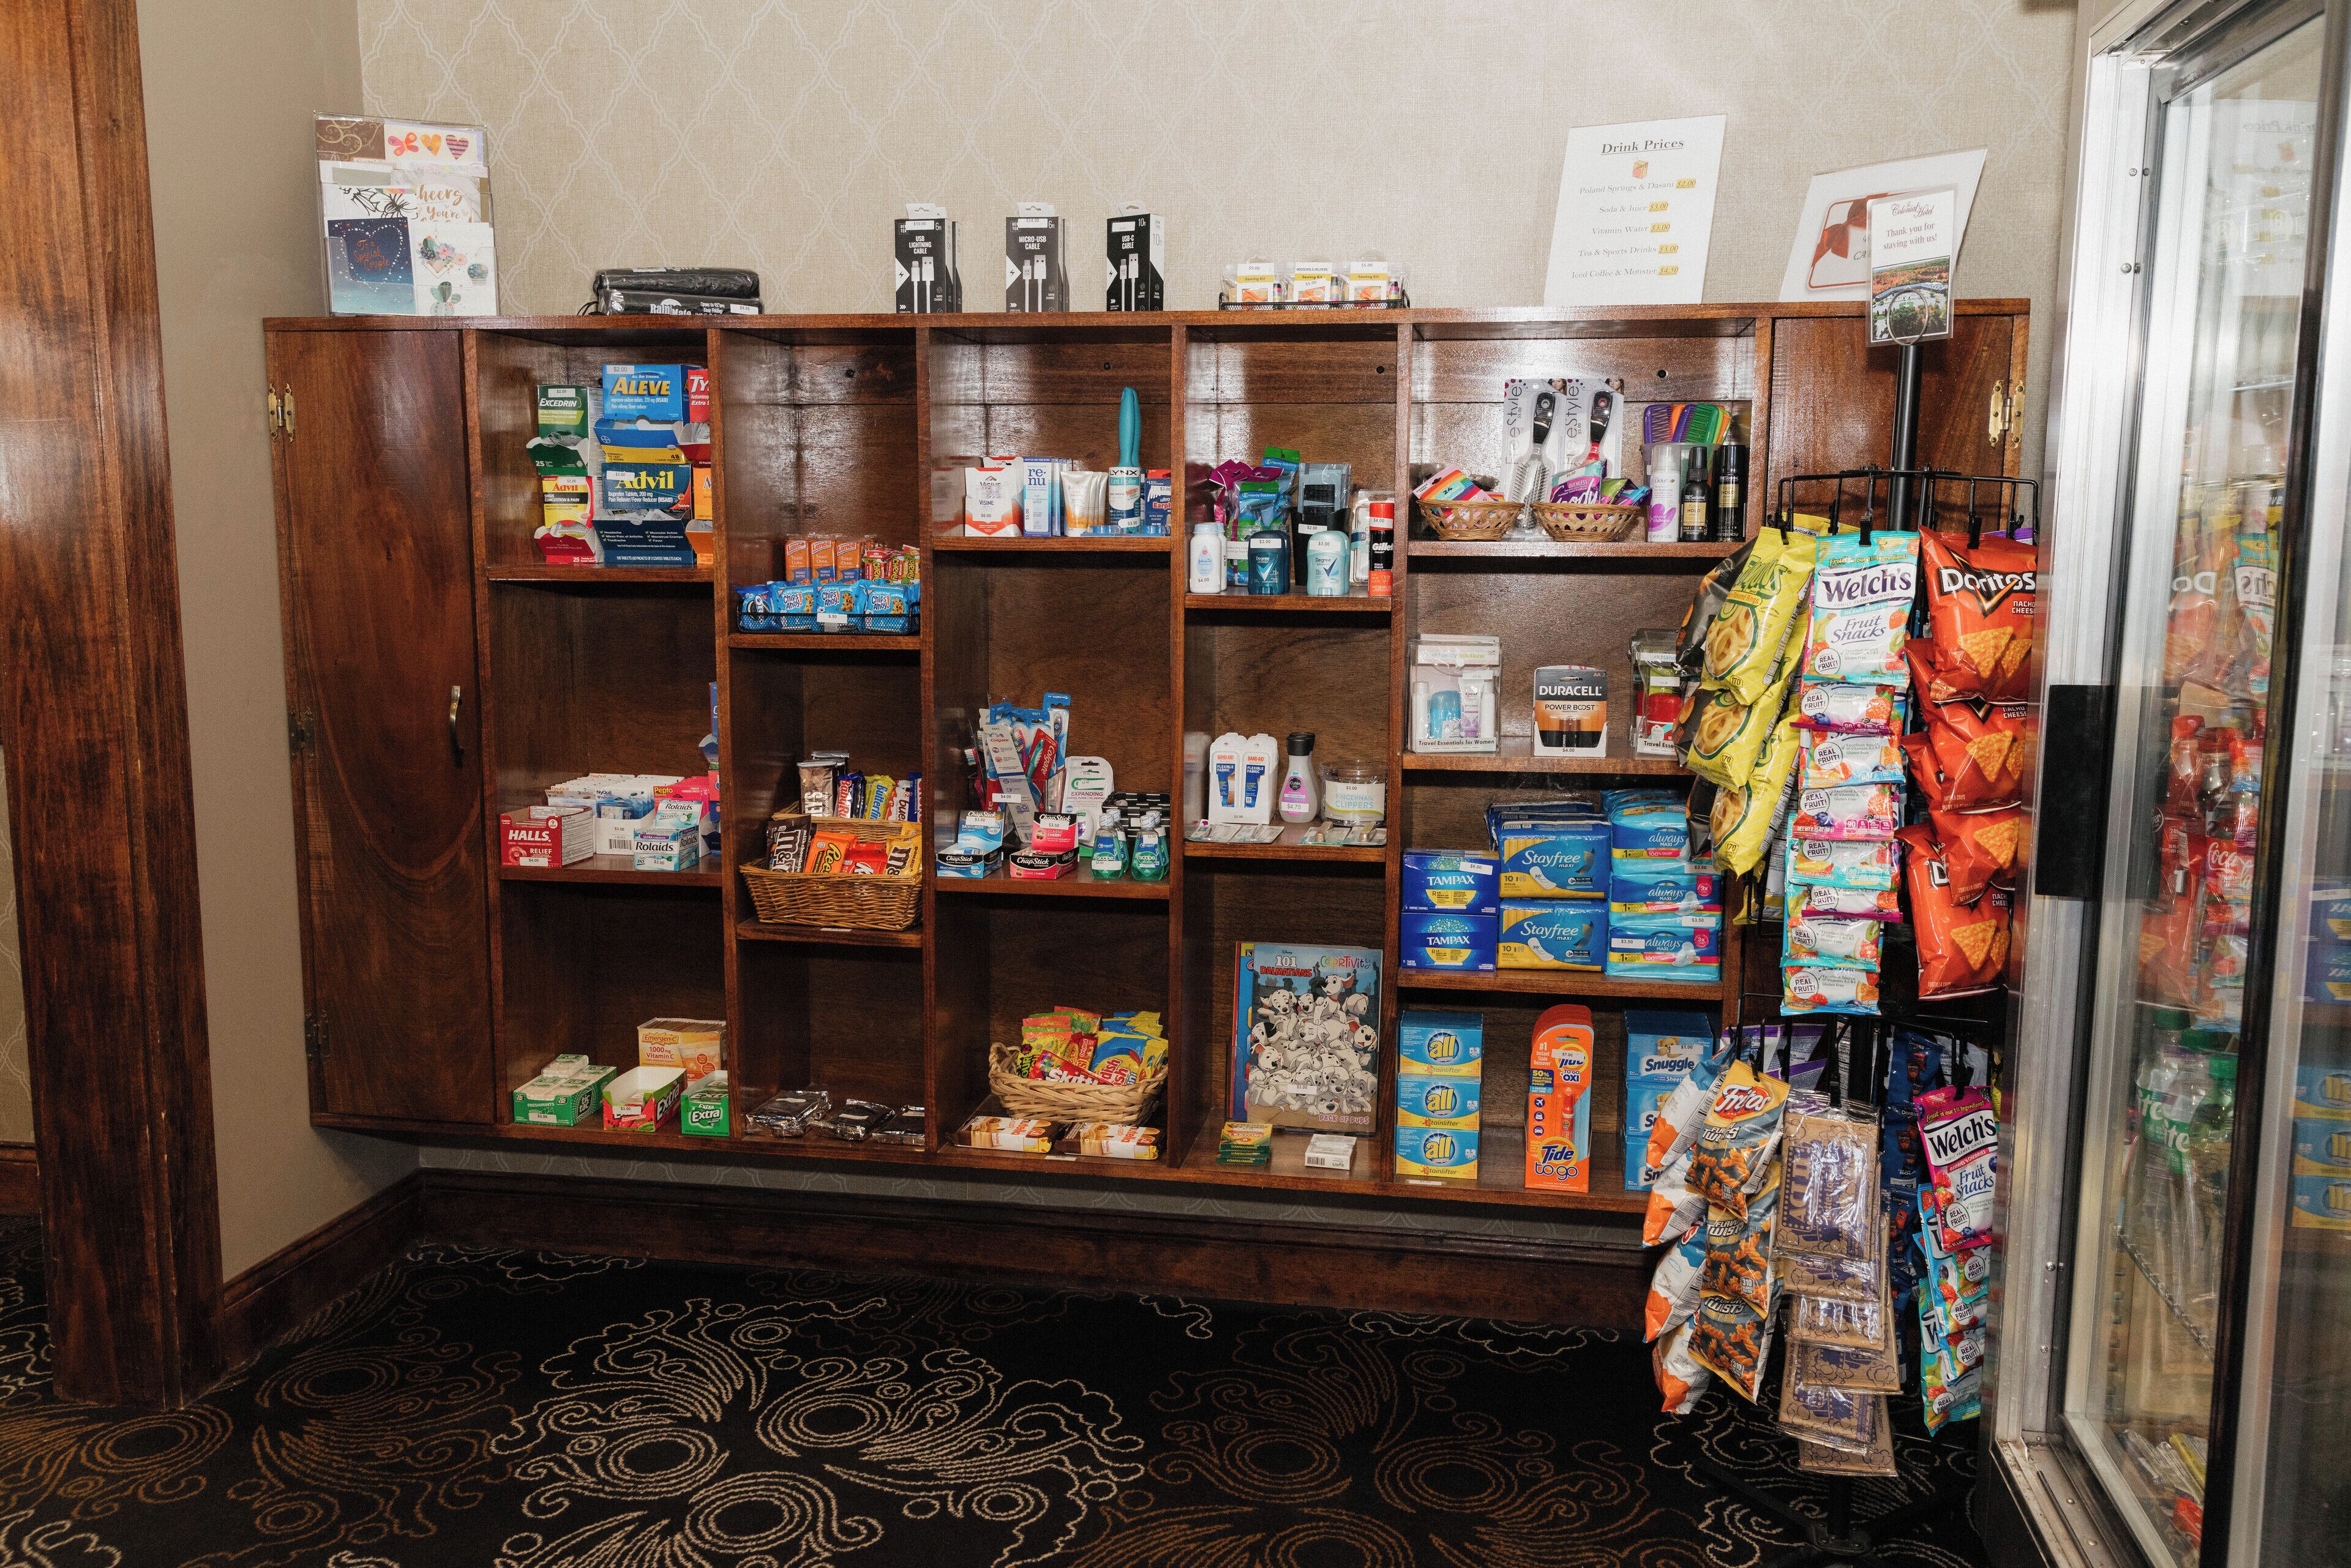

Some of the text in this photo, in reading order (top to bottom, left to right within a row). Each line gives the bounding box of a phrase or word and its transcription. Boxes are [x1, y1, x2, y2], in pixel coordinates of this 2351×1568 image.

[1602, 139, 1684, 154] Drink Prices
[1580, 186, 1605, 194] Poland
[1607, 185, 1637, 193] Springs
[1649, 202, 1668, 211] $3.00
[1891, 202, 1935, 218] Colonial Hotel
[1886, 222, 1935, 238] Thank you for
[1883, 239, 1907, 250] staying
[1910, 236, 1924, 245] with
[1603, 249, 1627, 257] Sports
[610, 377, 671, 396] ALEVE
[539, 398, 577, 407] EXCEDRIN
[614, 470, 675, 489] Advil
[1569, 479, 1588, 489] OUCHLESS
[787, 541, 806, 552] Lance
[812, 540, 831, 551] Lance
[1822, 568, 1911, 602] Welch's
[1941, 568, 2036, 593] Doritos
[1844, 615, 1881, 631] Fruit
[1831, 626, 1887, 643] Snacks
[1818, 662, 1839, 670] FRUIT!
[1539, 685, 1600, 696] DURACELL
[1806, 694, 1823, 702] REAL
[1041, 746, 1057, 776] Colgate
[1648, 831, 1685, 846] always
[636, 842, 674, 852] Rolaids
[1521, 849, 1581, 867] Stayfree
[1427, 874, 1475, 886] TAMPAX
[1648, 886, 1684, 900] always
[1520, 920, 1579, 939] Stayfree
[1427, 935, 1470, 945] TAMPAX
[1275, 955, 1297, 968] 101
[1260, 965, 1313, 978] DALMATIANS
[1079, 1038, 1089, 1057] Original
[1428, 1035, 1457, 1057] all
[1539, 1041, 1547, 1051] #1
[1645, 1058, 1694, 1072] Snuggle
[581, 1093, 591, 1106] tic
[657, 1084, 680, 1121] Extra
[1426, 1089, 1454, 1111] all
[1714, 1083, 1771, 1114] Fritos
[579, 1101, 590, 1114] tac
[692, 1109, 721, 1123] Extra
[1319, 1114, 1338, 1122] PACK
[1350, 1116, 1370, 1124] PUPS
[1928, 1115, 1997, 1159] Welch's
[1425, 1136, 1453, 1158] all
[1541, 1145, 1575, 1164] Tide
[1956, 1147, 1970, 1157] FARMER
[1971, 1139, 1985, 1150] OWNED
[1535, 1161, 1578, 1180] to go
[1960, 1164, 1986, 1185] Fruit
[1956, 1176, 1994, 1200] Snacks
[1742, 1278, 1753, 1286] 310
